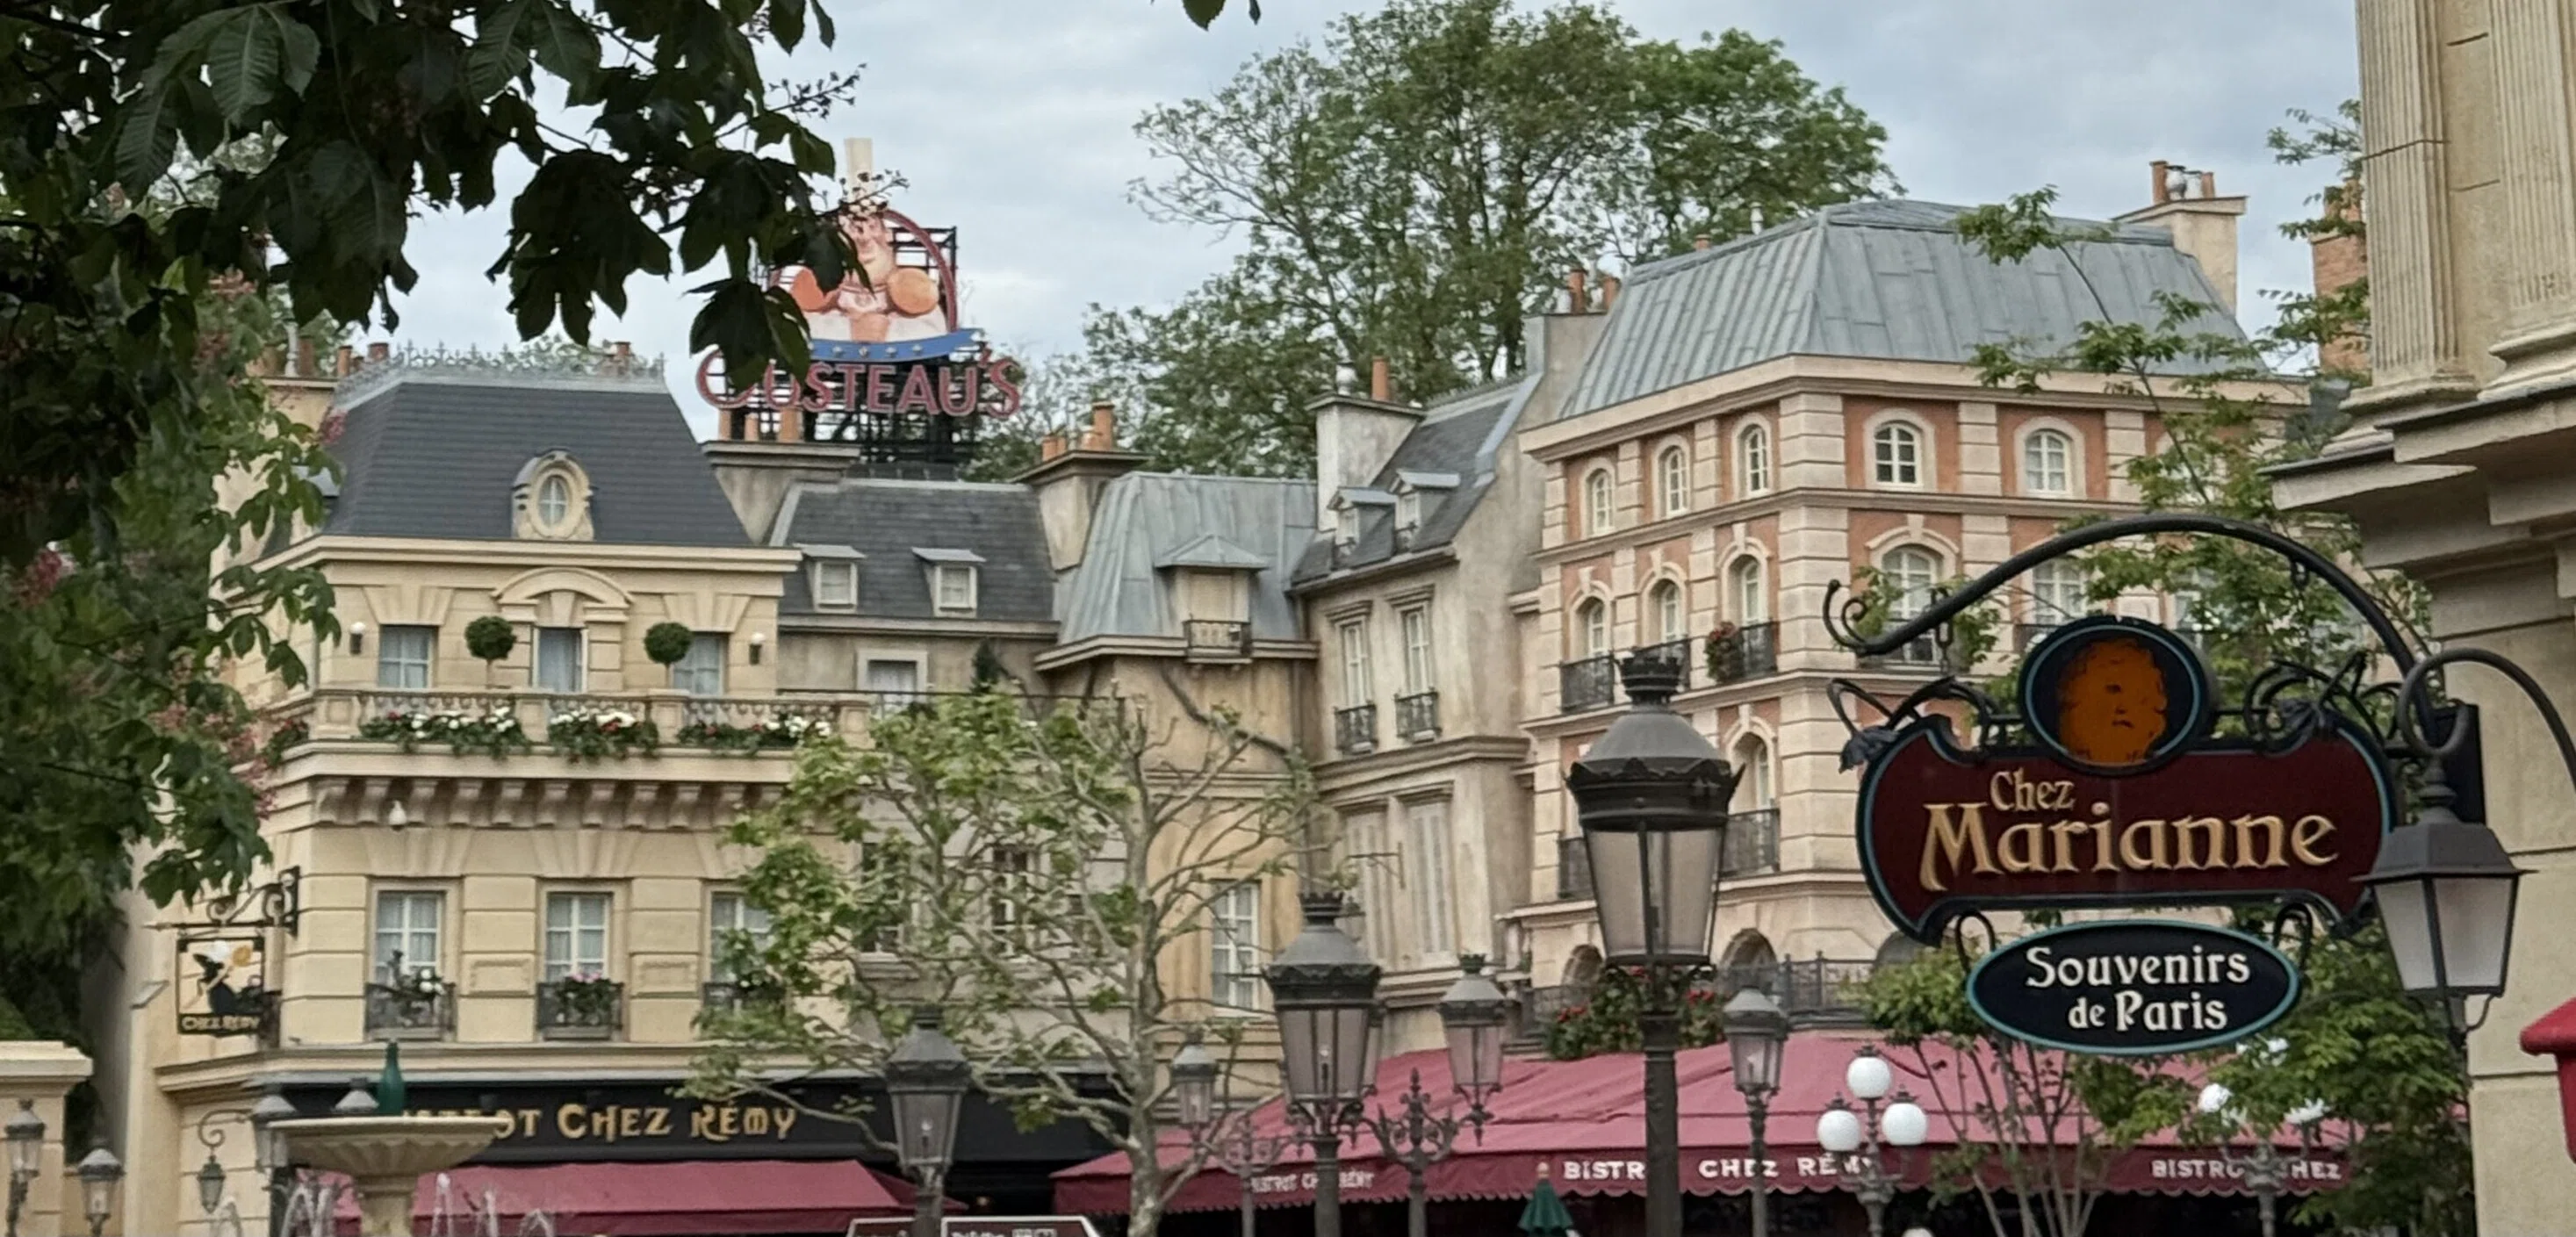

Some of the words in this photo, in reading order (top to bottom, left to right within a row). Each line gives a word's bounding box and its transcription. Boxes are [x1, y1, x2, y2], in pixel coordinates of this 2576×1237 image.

[1990, 768, 2076, 812] Chez
[1919, 802, 2339, 891] Marianne
[2026, 945, 2250, 988] Souvenirs
[2068, 996, 2105, 1029] de
[2114, 991, 2228, 1032] Paris
[557, 1103, 673, 1142] CHEZ
[690, 1100, 795, 1141] RÉMY
[1562, 1160, 1646, 1180] BISTR
[2151, 1159, 2245, 1179] BISTRO
[2291, 1159, 2342, 1180] HEZ
